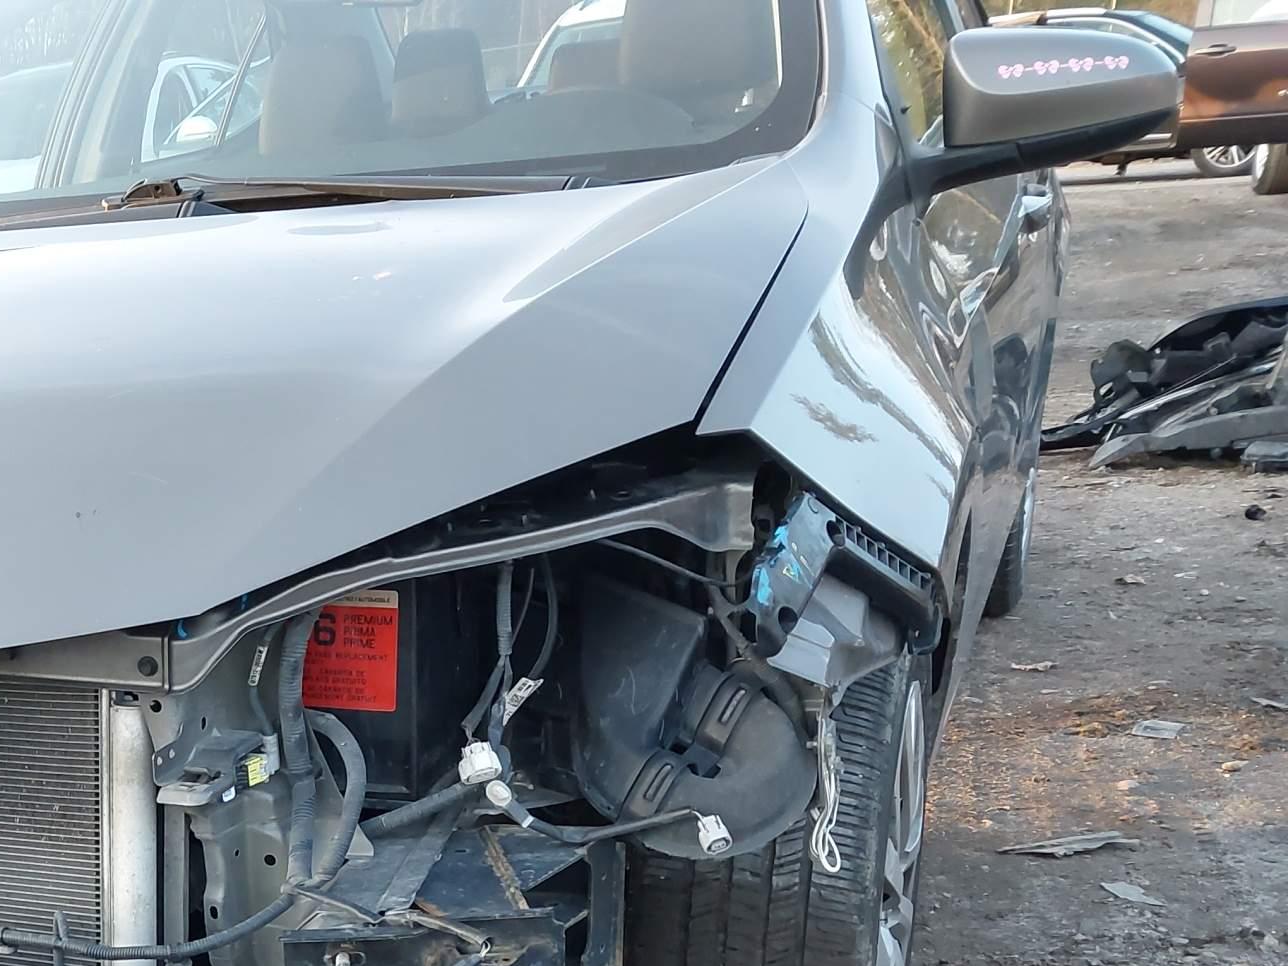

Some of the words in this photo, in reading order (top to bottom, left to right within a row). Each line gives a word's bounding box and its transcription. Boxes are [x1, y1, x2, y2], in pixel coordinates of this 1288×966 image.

[343, 614, 393, 625] PREMIUM
[343, 626, 376, 637] PRIMA
[343, 637, 376, 648] PRIME
